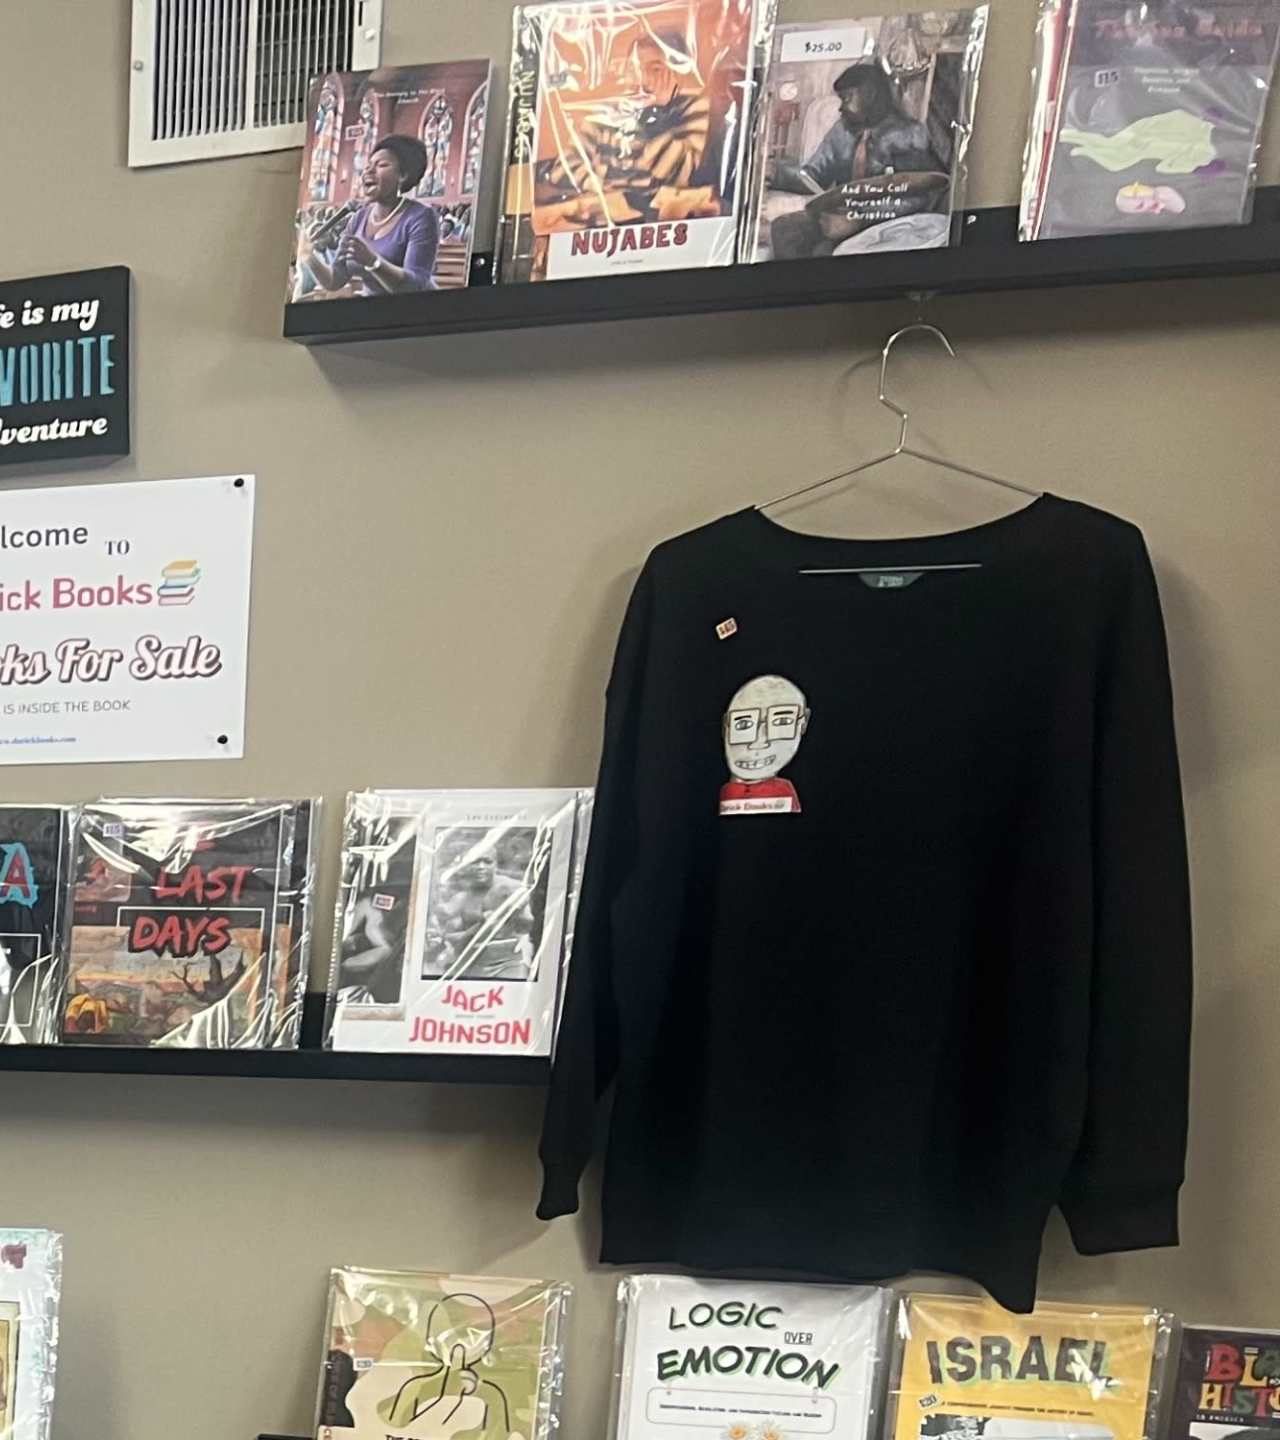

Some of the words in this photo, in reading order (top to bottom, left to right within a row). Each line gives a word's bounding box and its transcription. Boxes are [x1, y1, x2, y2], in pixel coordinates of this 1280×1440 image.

[804, 40, 843, 53] $25.00
[888, 182, 909, 194] Call
[845, 209, 897, 221] Christian
[570, 222, 689, 258] NUJABES
[21, 300, 44, 325] is
[51, 298, 101, 331] my
[104, 539, 130, 556] TO
[52, 575, 154, 609] Books
[54, 637, 125, 684] For
[129, 635, 224, 682] Sale
[3, 703, 16, 715] IS
[18, 702, 61, 715] INSIDE
[64, 701, 90, 713] THE
[93, 699, 132, 712] BOOK
[154, 864, 255, 905] LAST
[128, 914, 232, 958] DAYS
[440, 984, 505, 1013] JACK
[408, 1016, 532, 1045] JOHNSON
[668, 1300, 784, 1331] LOGIC
[784, 1331, 814, 1345] OVER
[655, 1343, 840, 1390] EMOTION
[925, 1334, 1119, 1388] ISRAEL
